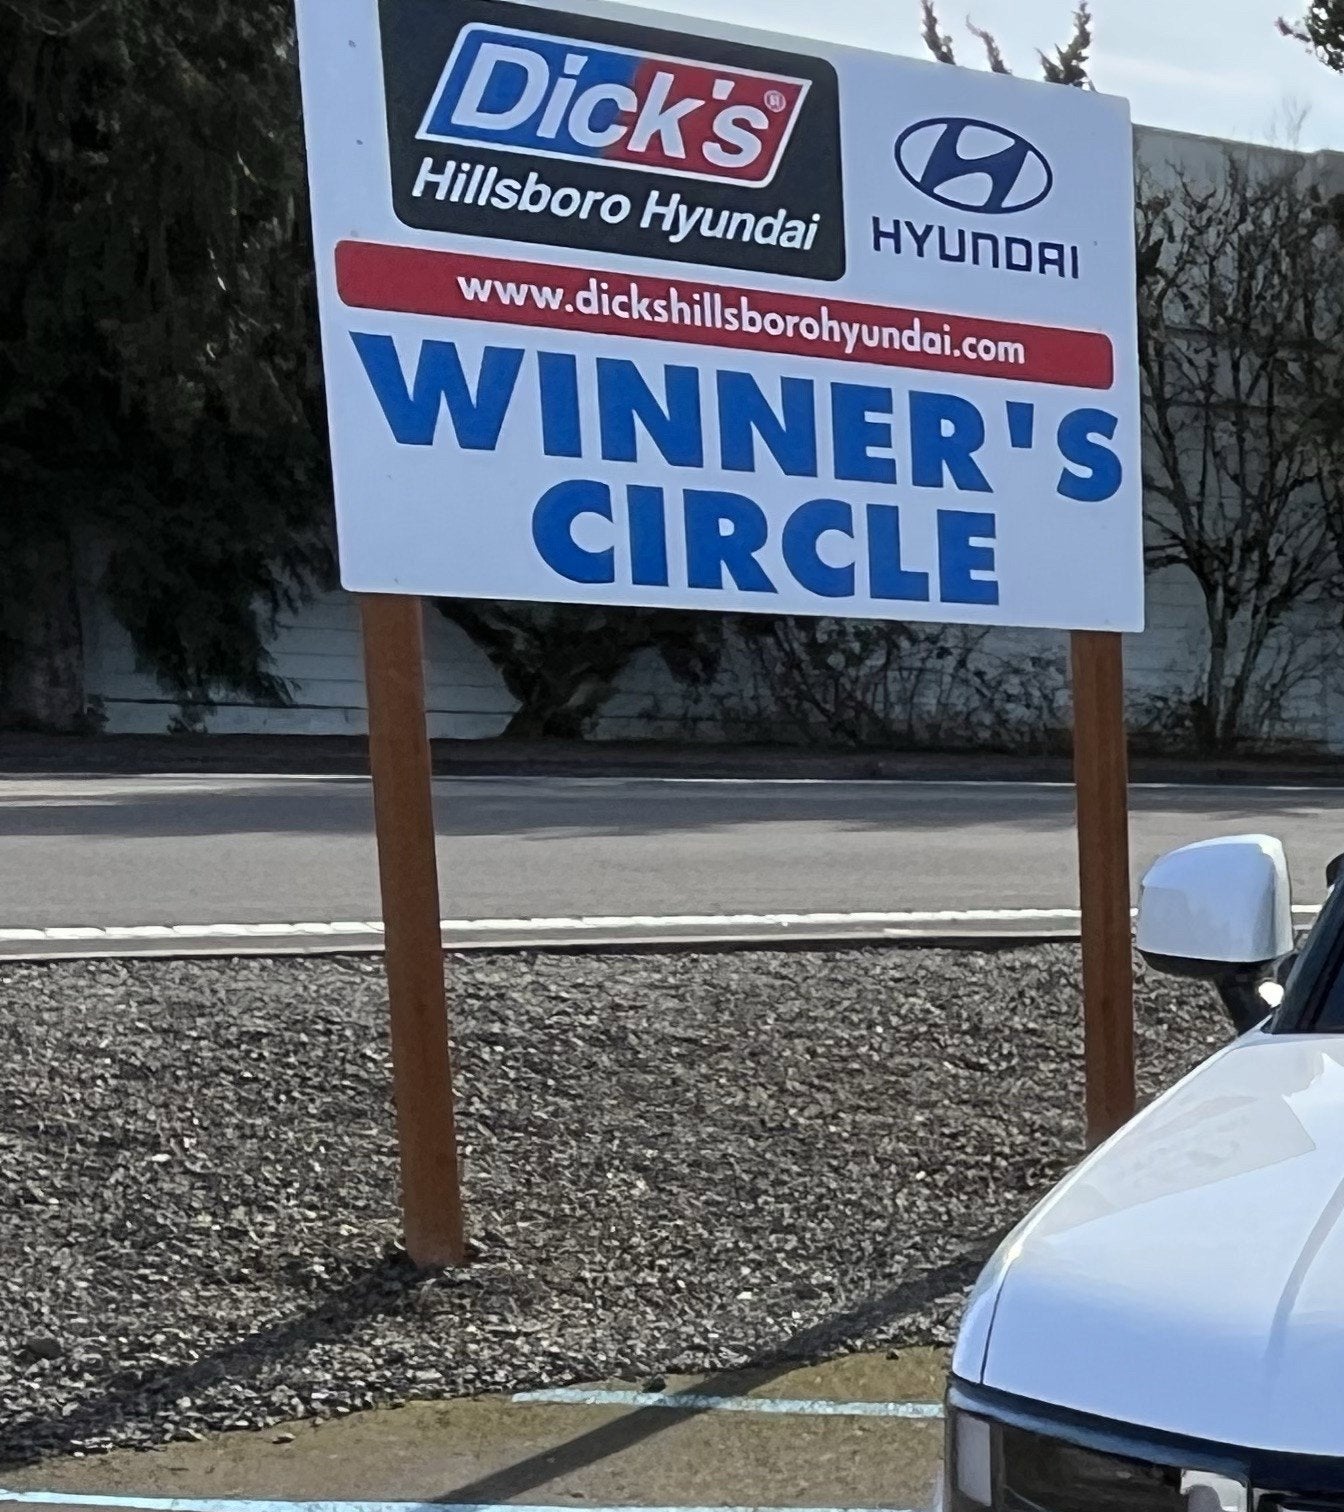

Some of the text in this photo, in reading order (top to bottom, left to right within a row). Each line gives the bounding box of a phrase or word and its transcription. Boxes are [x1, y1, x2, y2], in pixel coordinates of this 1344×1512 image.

[450, 42, 770, 170] Dick's
[412, 158, 821, 252] Hillsboro Hyundai
[872, 216, 1080, 280] HYUNDAI
[456, 273, 1026, 365] www.dickshillsborohyundai.com
[349, 332, 1123, 503] WINNER'S
[532, 480, 1000, 606] CIRCLE
